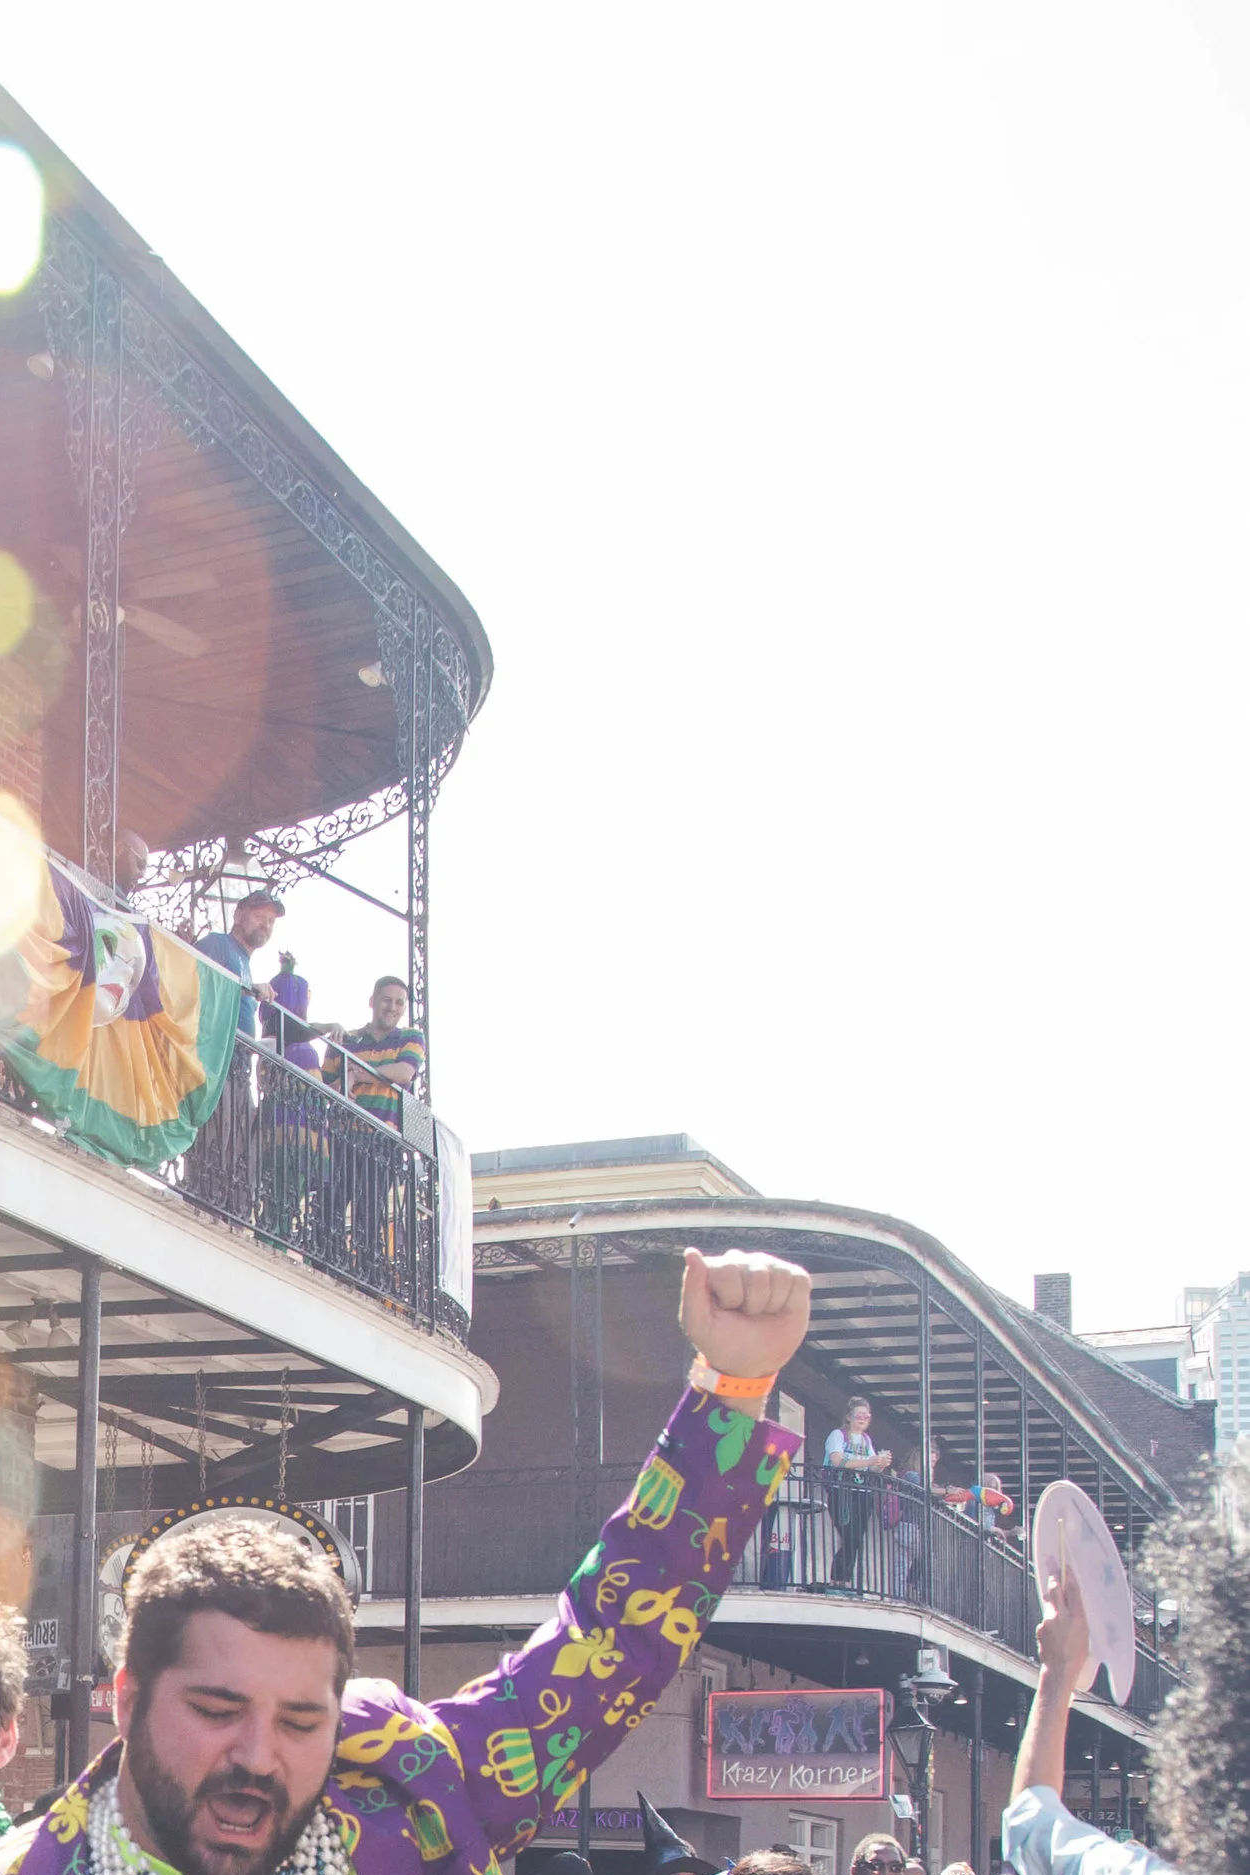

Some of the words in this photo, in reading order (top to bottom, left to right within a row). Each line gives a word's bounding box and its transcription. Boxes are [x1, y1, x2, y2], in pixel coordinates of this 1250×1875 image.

[722, 1760, 783, 1790] Krazy
[789, 1763, 873, 1790] Korner
[594, 1810, 644, 1829] KORN
